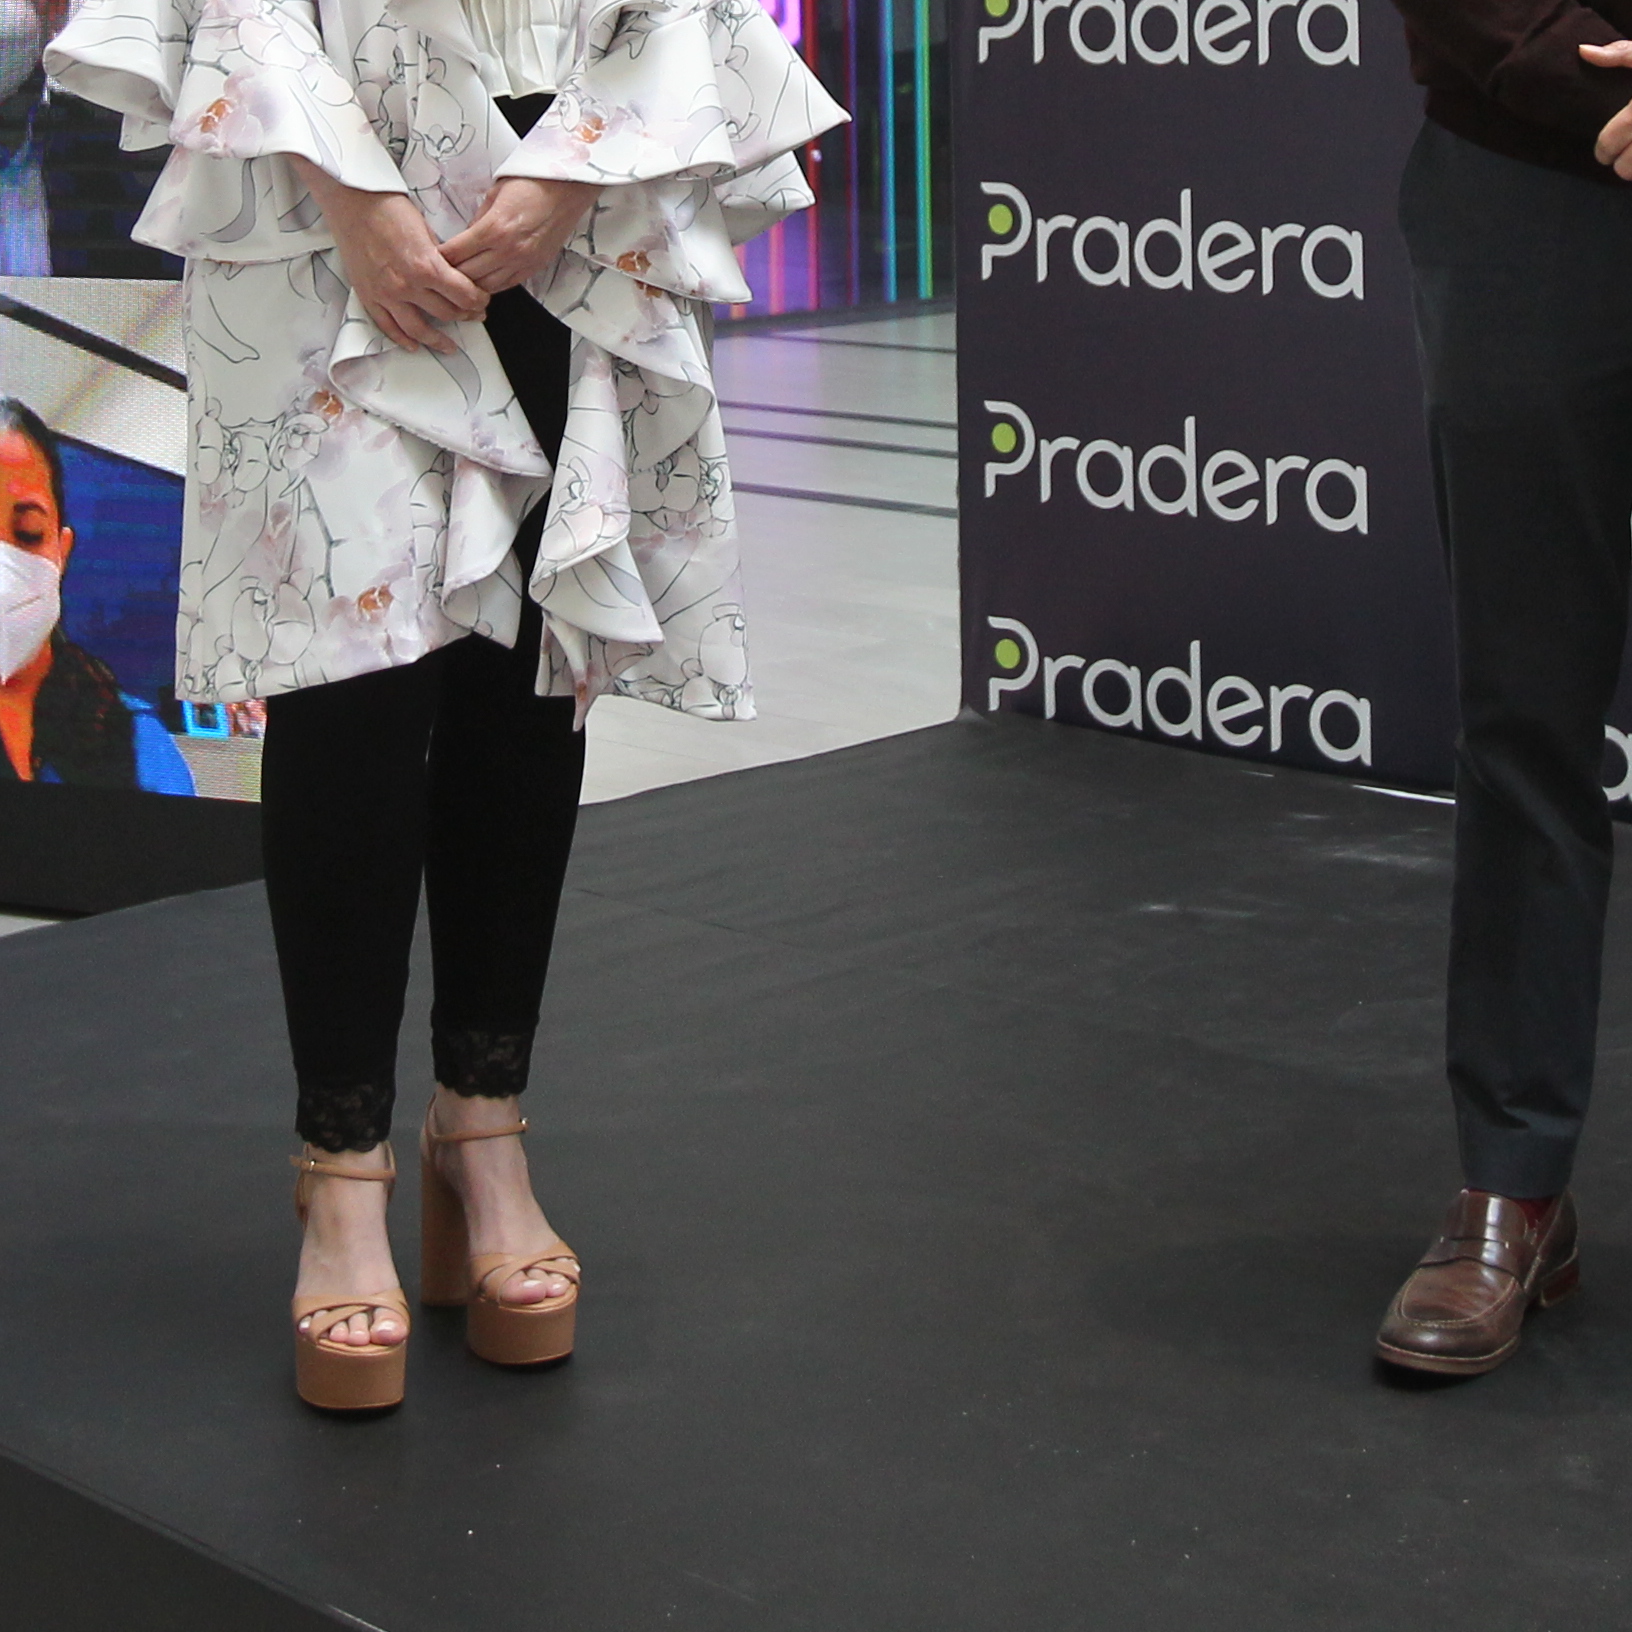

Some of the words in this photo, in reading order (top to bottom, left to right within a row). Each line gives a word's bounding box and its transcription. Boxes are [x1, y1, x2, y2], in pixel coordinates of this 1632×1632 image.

[981, 182, 1363, 299] Pradera
[984, 401, 1368, 534] Pradera
[988, 616, 1371, 766] Pradera
